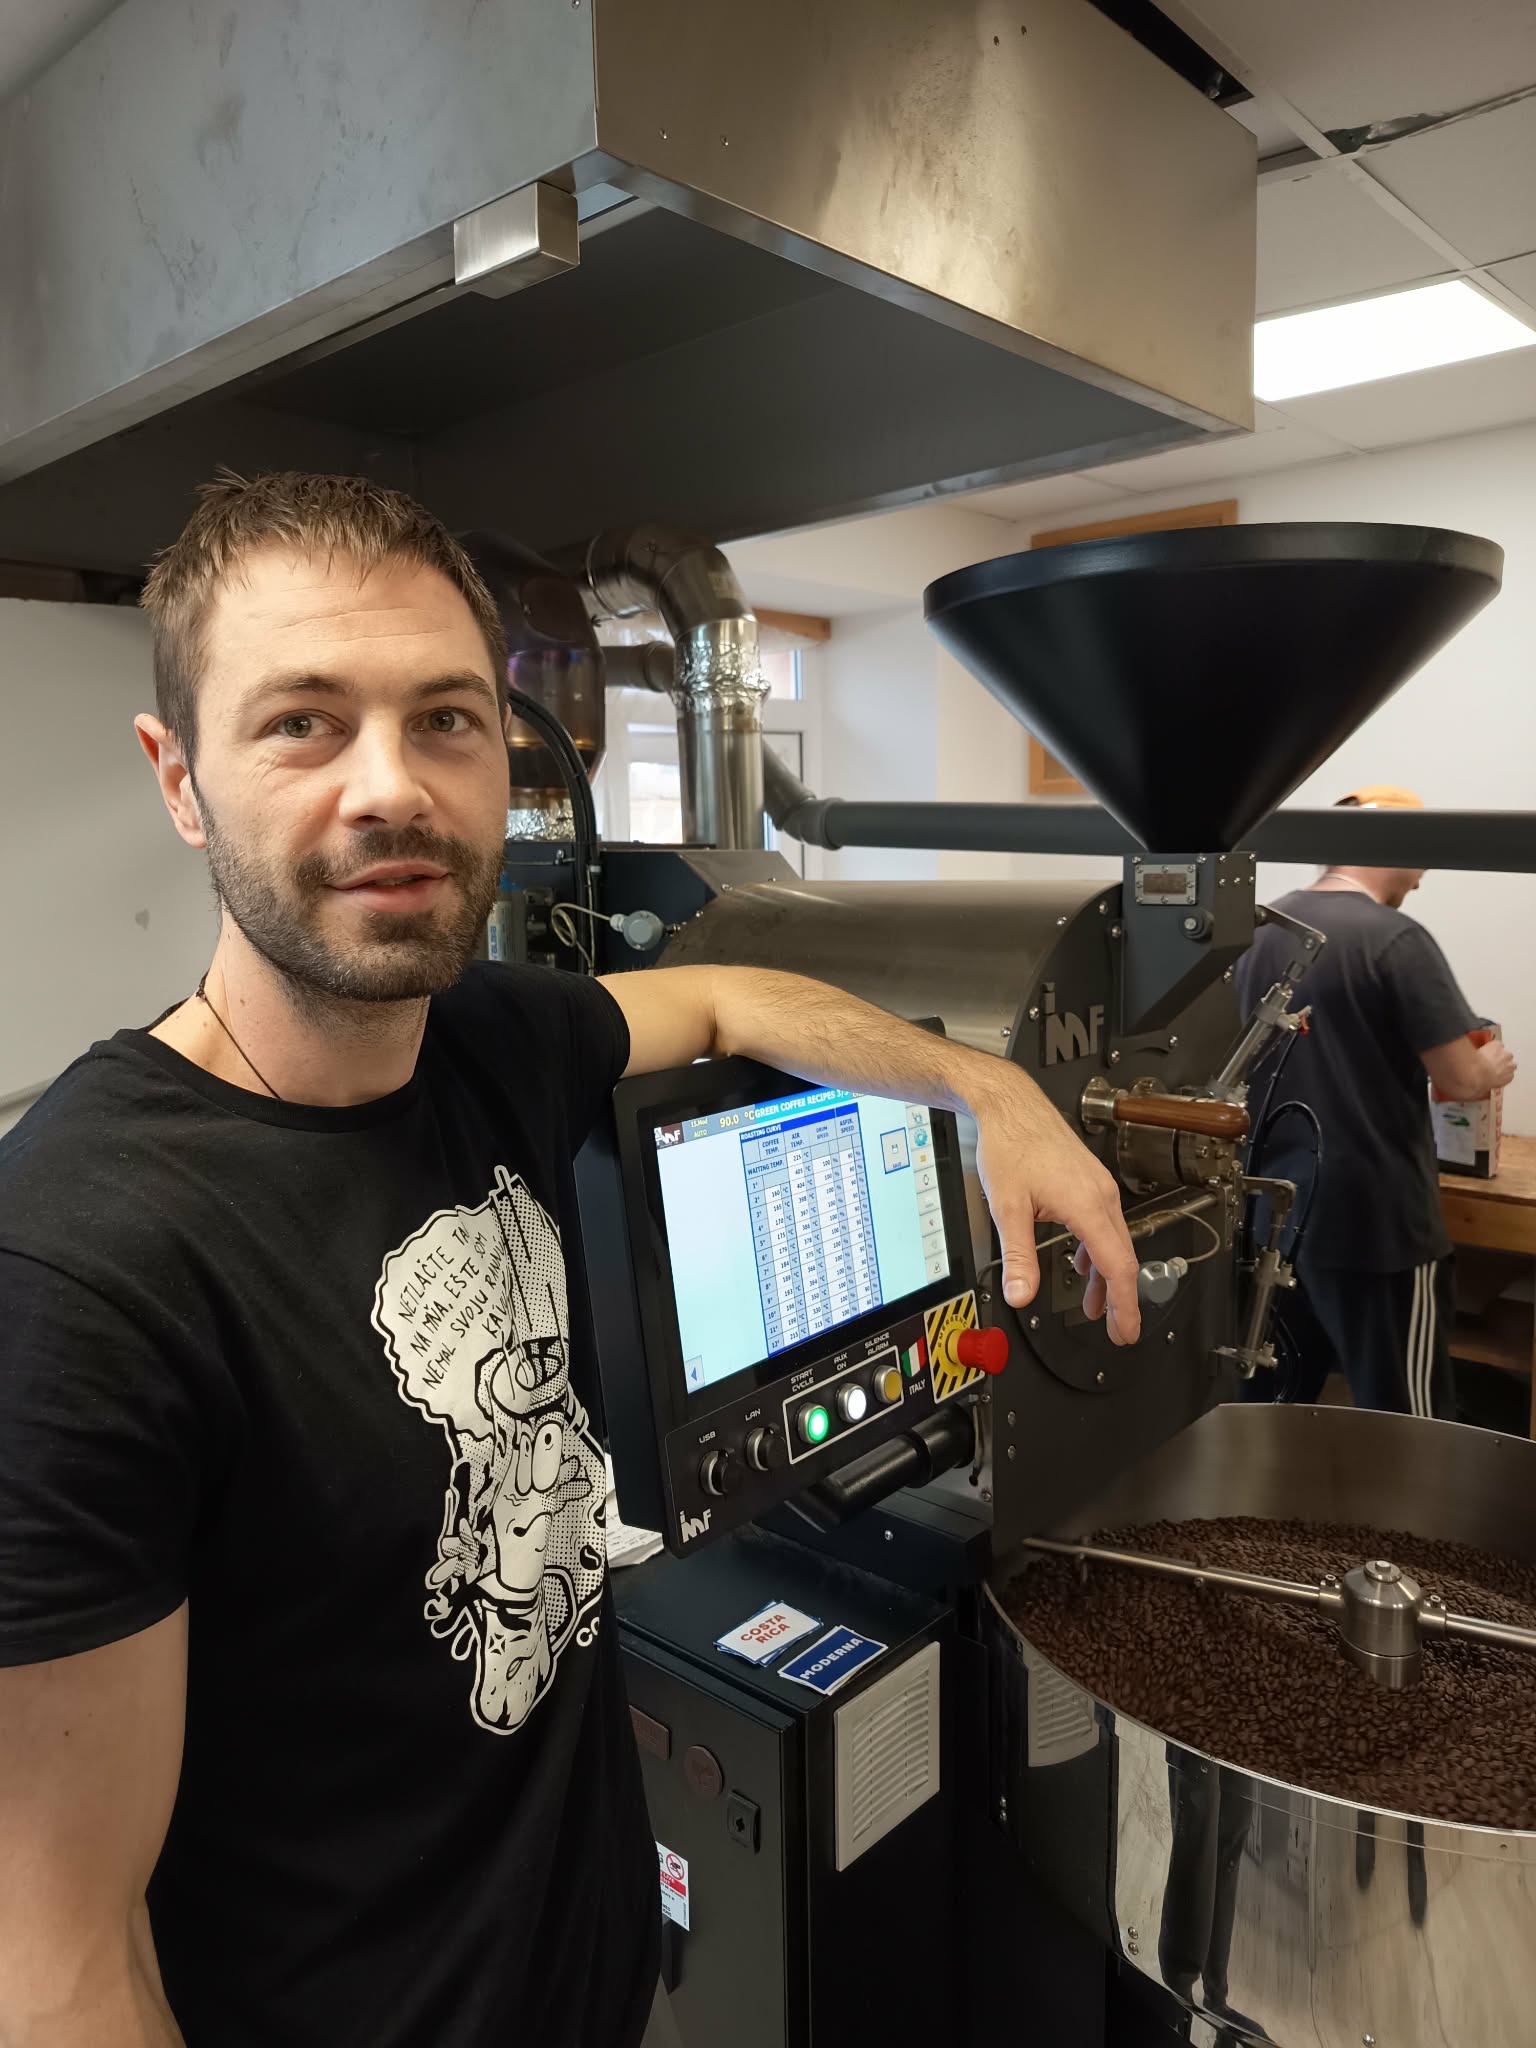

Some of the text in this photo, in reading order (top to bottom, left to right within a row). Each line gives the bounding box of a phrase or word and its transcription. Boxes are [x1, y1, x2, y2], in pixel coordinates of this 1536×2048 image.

[755, 1105, 779, 1118] GREEN
[780, 1099, 806, 1111] COFFEE
[807, 1092, 836, 1104] RECIPES
[719, 1114, 739, 1128] 90.0
[762, 1138, 779, 1148] COFFEE
[747, 1164, 770, 1176] WAITING
[452, 1222, 470, 1246] TA
[410, 1333, 432, 1358] NA
[444, 1257, 480, 1299] EŠTE
[938, 1312, 968, 1348] EMERGENC
[422, 1343, 456, 1390] NEMAL
[450, 1289, 488, 1338] SVOJU
[864, 1332, 890, 1349] SILENCE
[867, 1340, 889, 1356] ALARM
[833, 1352, 848, 1364] AUX
[836, 1362, 847, 1371] ON
[790, 1368, 814, 1384] START
[792, 1376, 815, 1392] CYCLE
[908, 1379, 926, 1395] ITALY
[745, 1408, 761, 1421] LAN
[699, 1431, 716, 1444] USB
[740, 1614, 787, 1642] COSTA
[755, 1623, 790, 1644] RICA
[800, 1638, 864, 1681] MODERNA
